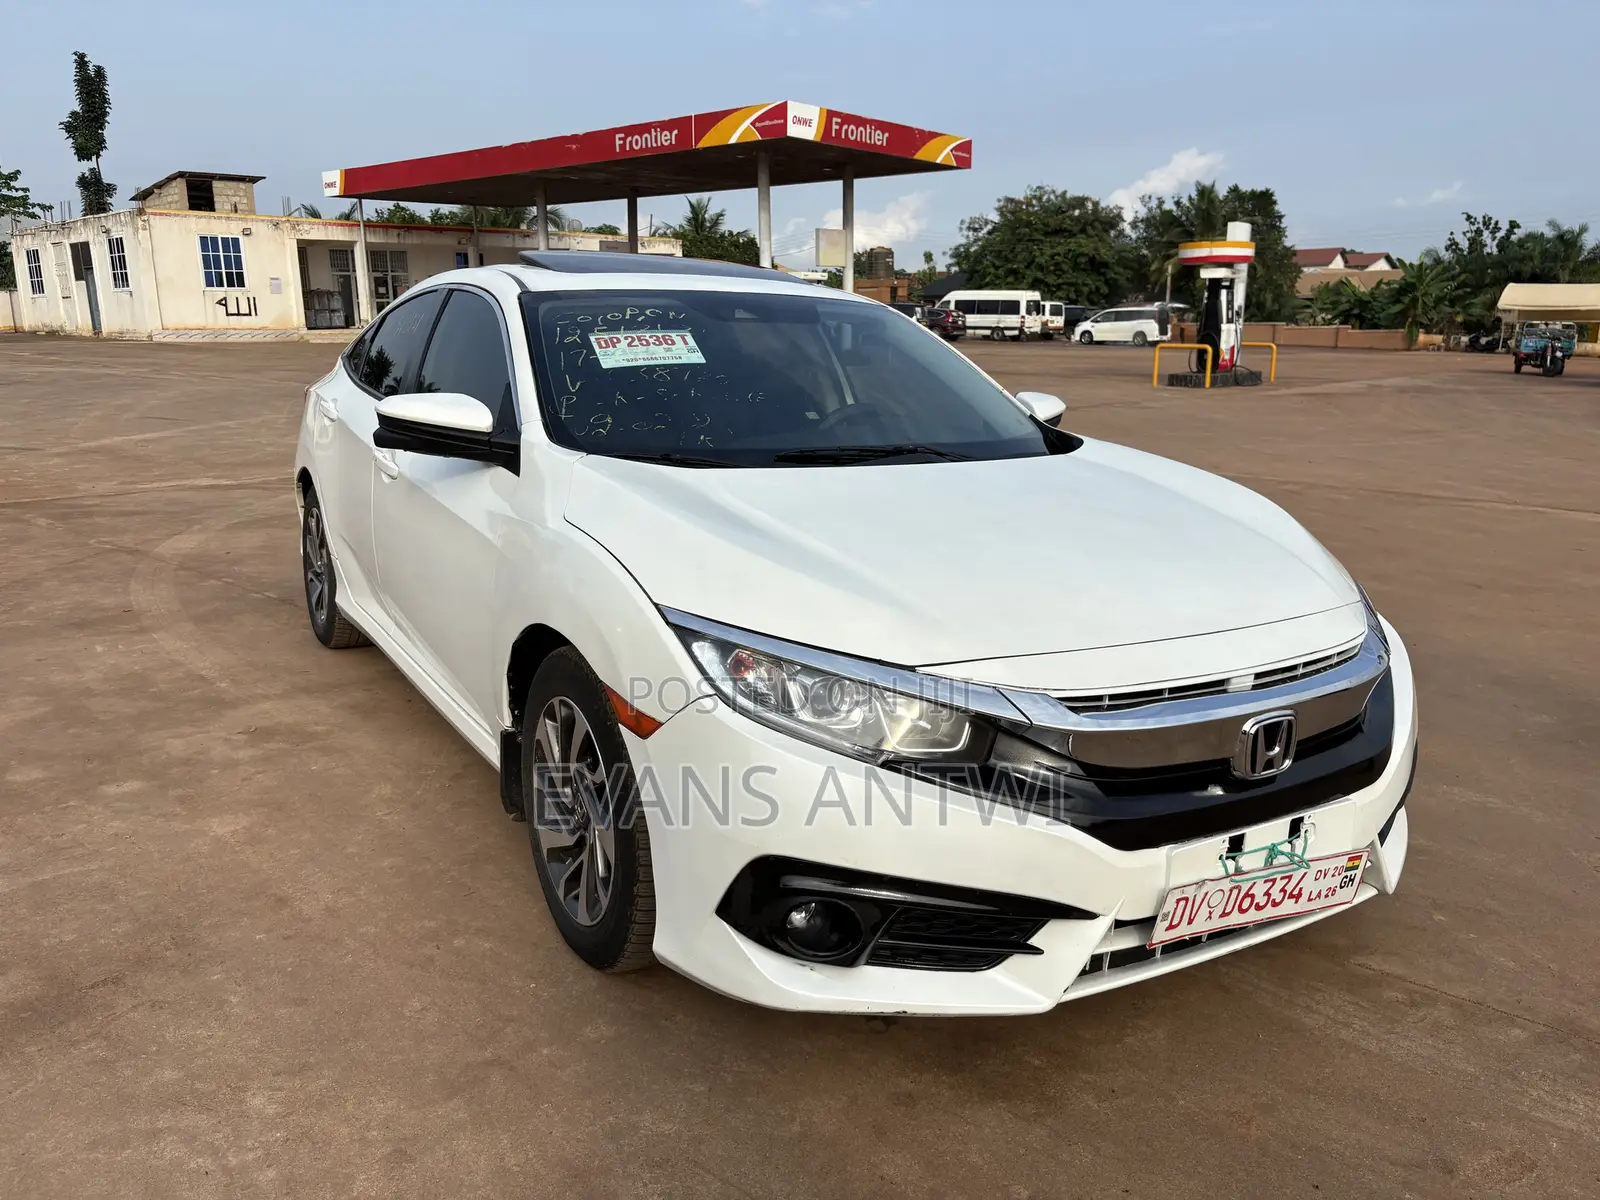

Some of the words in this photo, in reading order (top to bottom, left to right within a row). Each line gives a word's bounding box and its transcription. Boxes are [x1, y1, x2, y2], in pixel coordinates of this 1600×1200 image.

[792, 115, 813, 128] ONWE
[615, 127, 679, 153] Frontier
[832, 117, 889, 147] Frontier
[594, 336, 622, 350] DP
[624, 334, 677, 348] 2536
[676, 334, 690, 346] T
[1314, 868, 1329, 882] DV
[1331, 865, 1344, 879] 20
[1339, 873, 1357, 890] GH
[1165, 891, 1209, 932] DV
[1218, 871, 1309, 919] D6334
[1307, 889, 1321, 903] LA
[1324, 885, 1338, 899] 26
